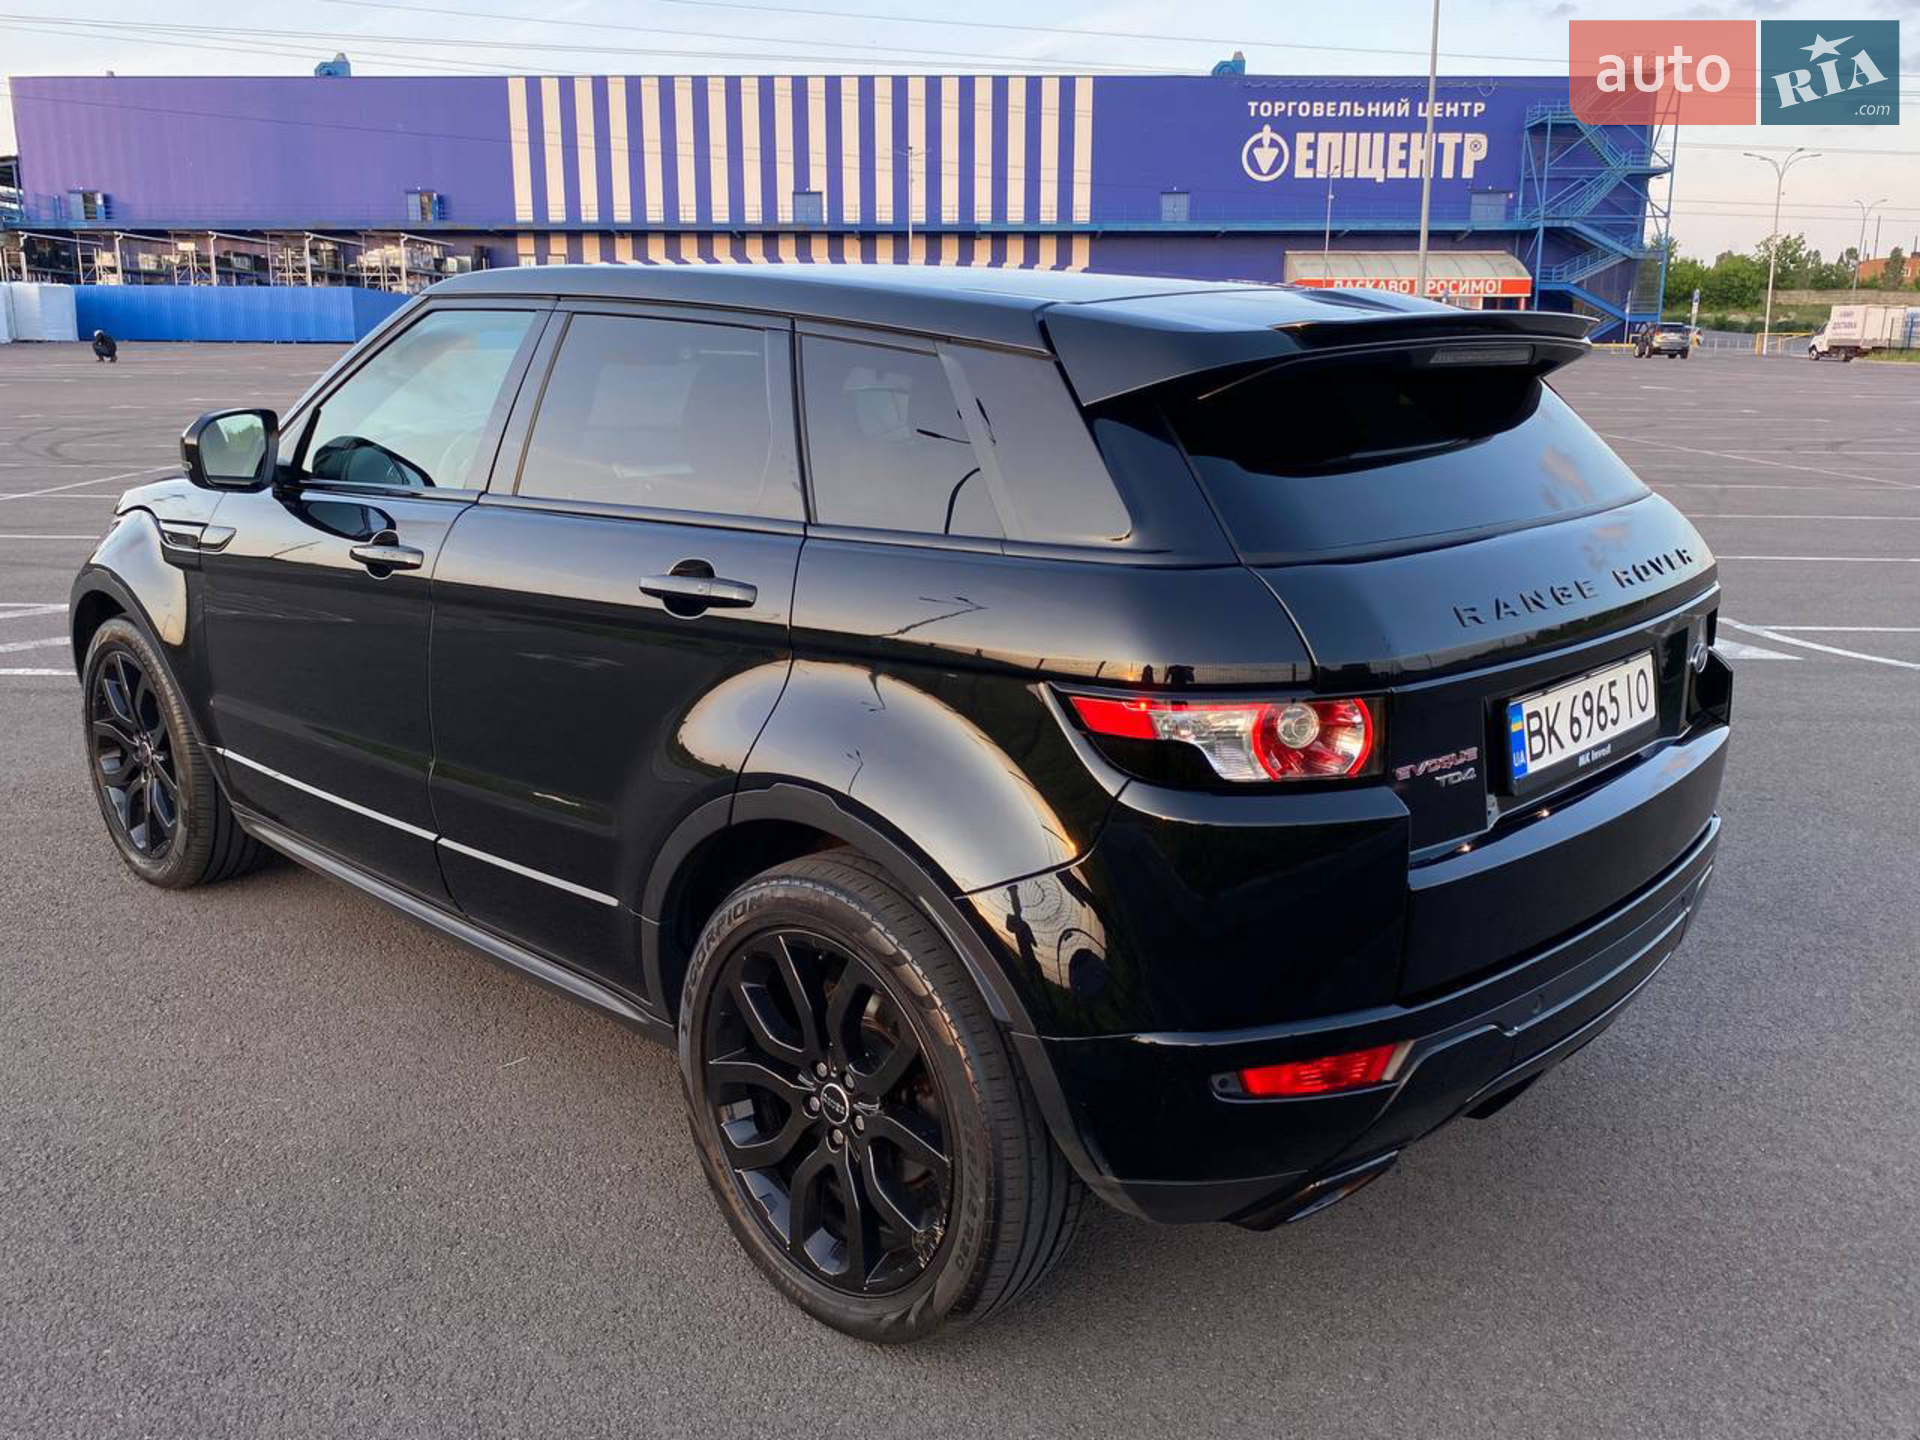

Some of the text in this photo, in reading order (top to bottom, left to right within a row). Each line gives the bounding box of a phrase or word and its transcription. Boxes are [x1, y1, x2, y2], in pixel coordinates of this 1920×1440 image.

[1247, 97, 1486, 119] ТОРГОВЕЛЬНИЙ ЦЕНТР
[1294, 131, 1488, 182] ЕПІЦЕНТР
[1452, 548, 1693, 628] RANGE ROVER
[1526, 701, 1565, 762] BK
[1570, 679, 1620, 743] 6965
[1396, 746, 1478, 781] EVOQUE
